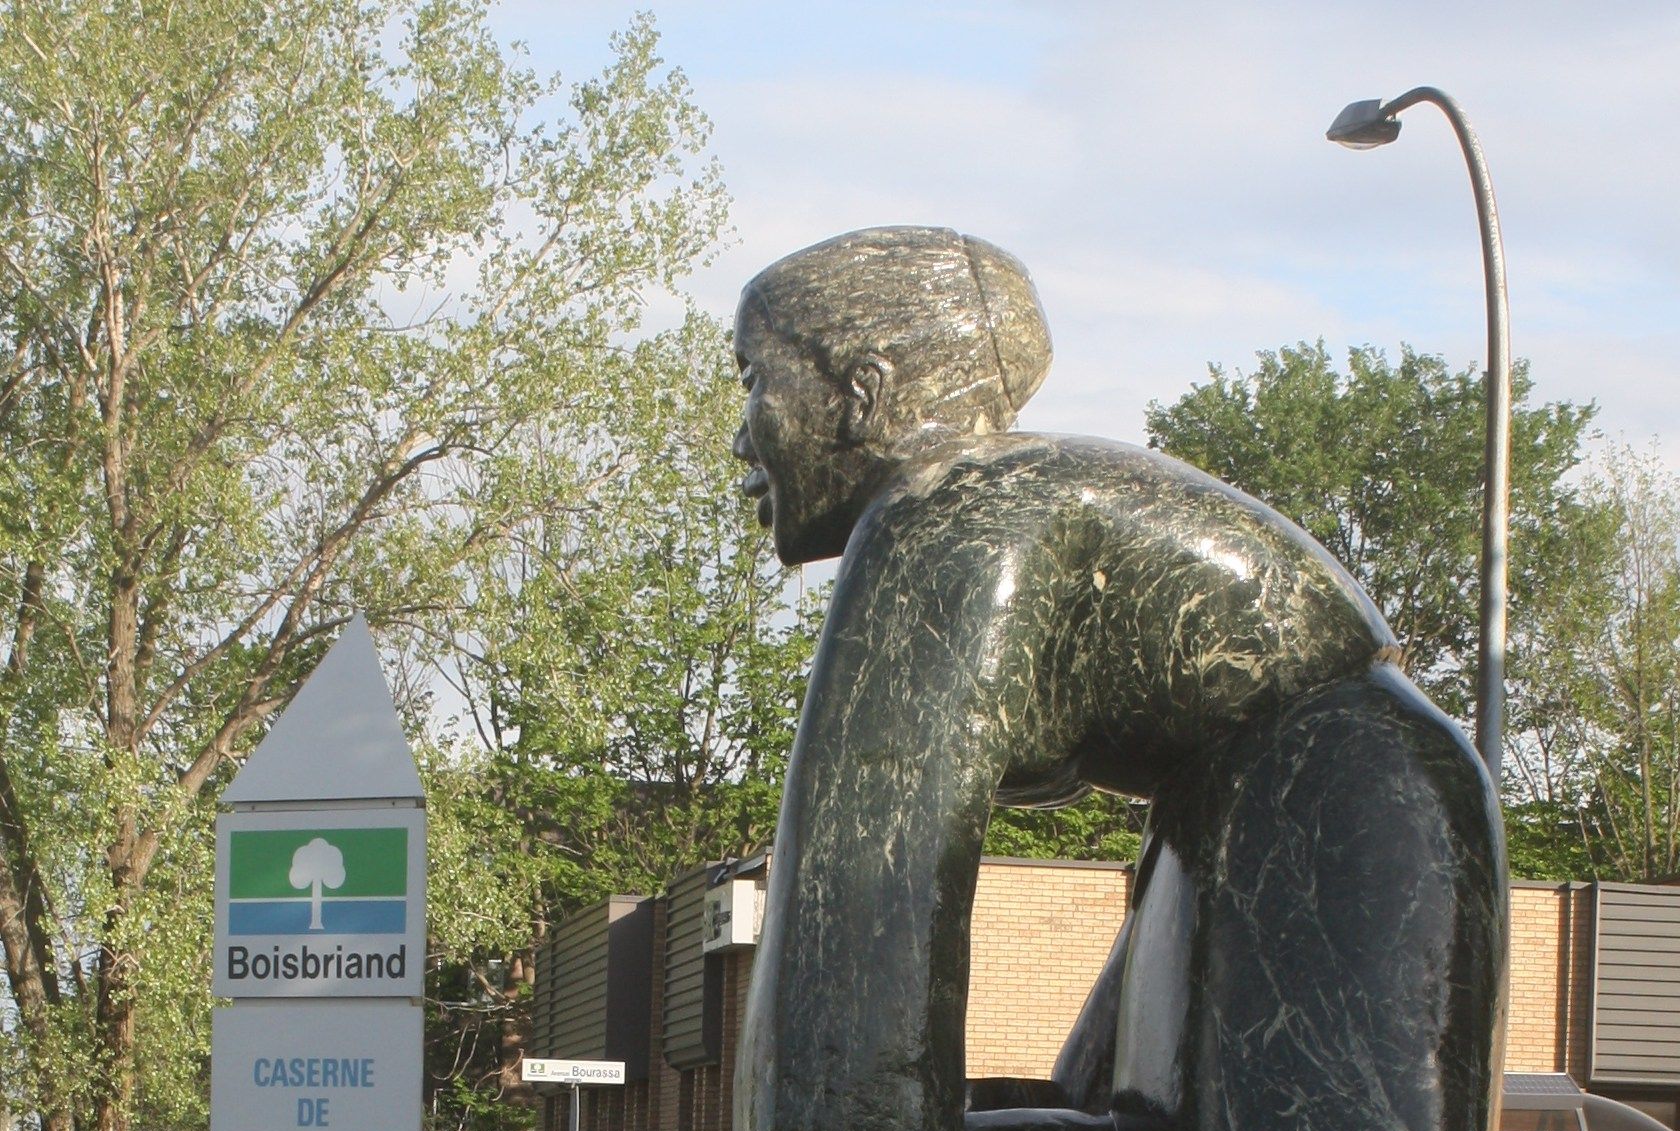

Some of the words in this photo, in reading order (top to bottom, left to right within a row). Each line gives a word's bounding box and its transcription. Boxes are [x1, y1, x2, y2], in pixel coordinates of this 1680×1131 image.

[228, 945, 406, 979] Boisbriand
[254, 1058, 375, 1087] CASERNE
[572, 1066, 620, 1078] Bourassa
[297, 1098, 329, 1127] DE
